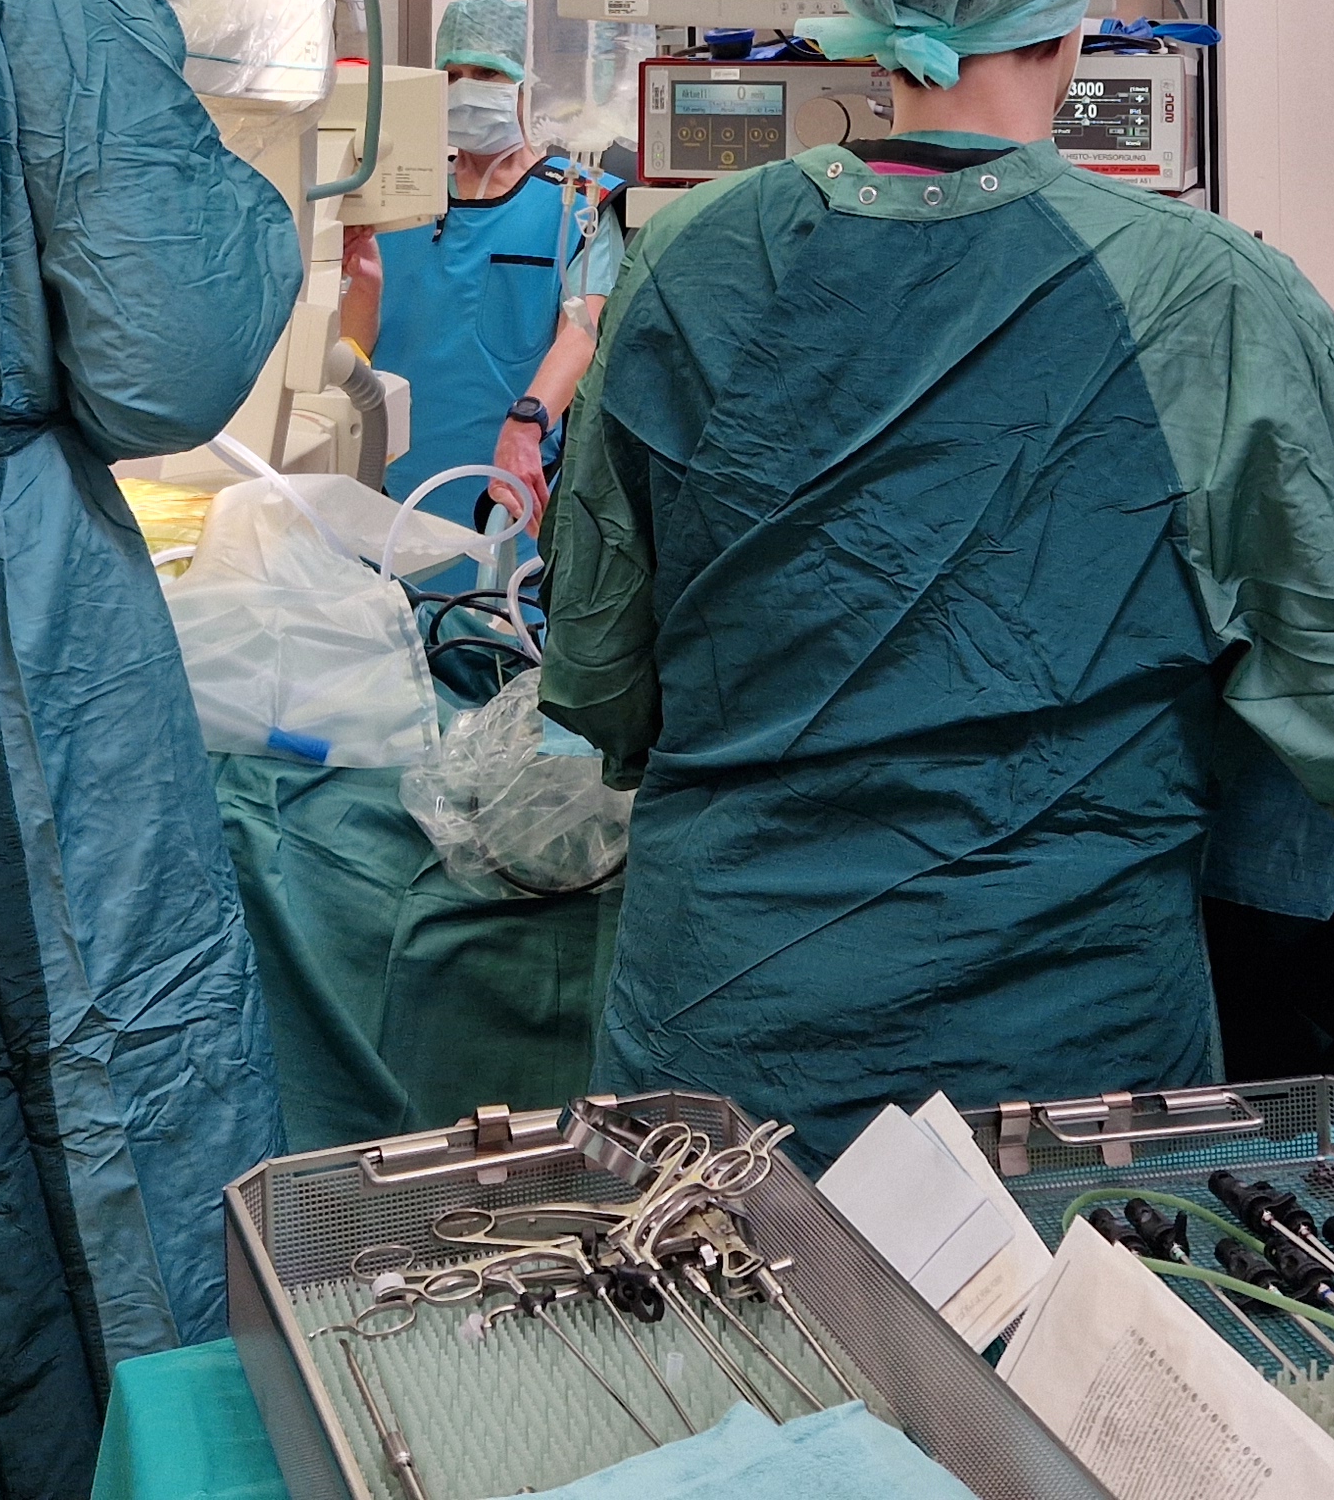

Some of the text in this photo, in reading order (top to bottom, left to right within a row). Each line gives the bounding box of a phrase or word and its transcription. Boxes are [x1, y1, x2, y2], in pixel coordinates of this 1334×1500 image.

[682, 88, 707, 99] Aktuell
[737, 86, 746, 100] 0
[1069, 82, 1104, 96] 3000
[1074, 104, 1097, 118] 2.0
[1165, 93, 1175, 123] WOLF
